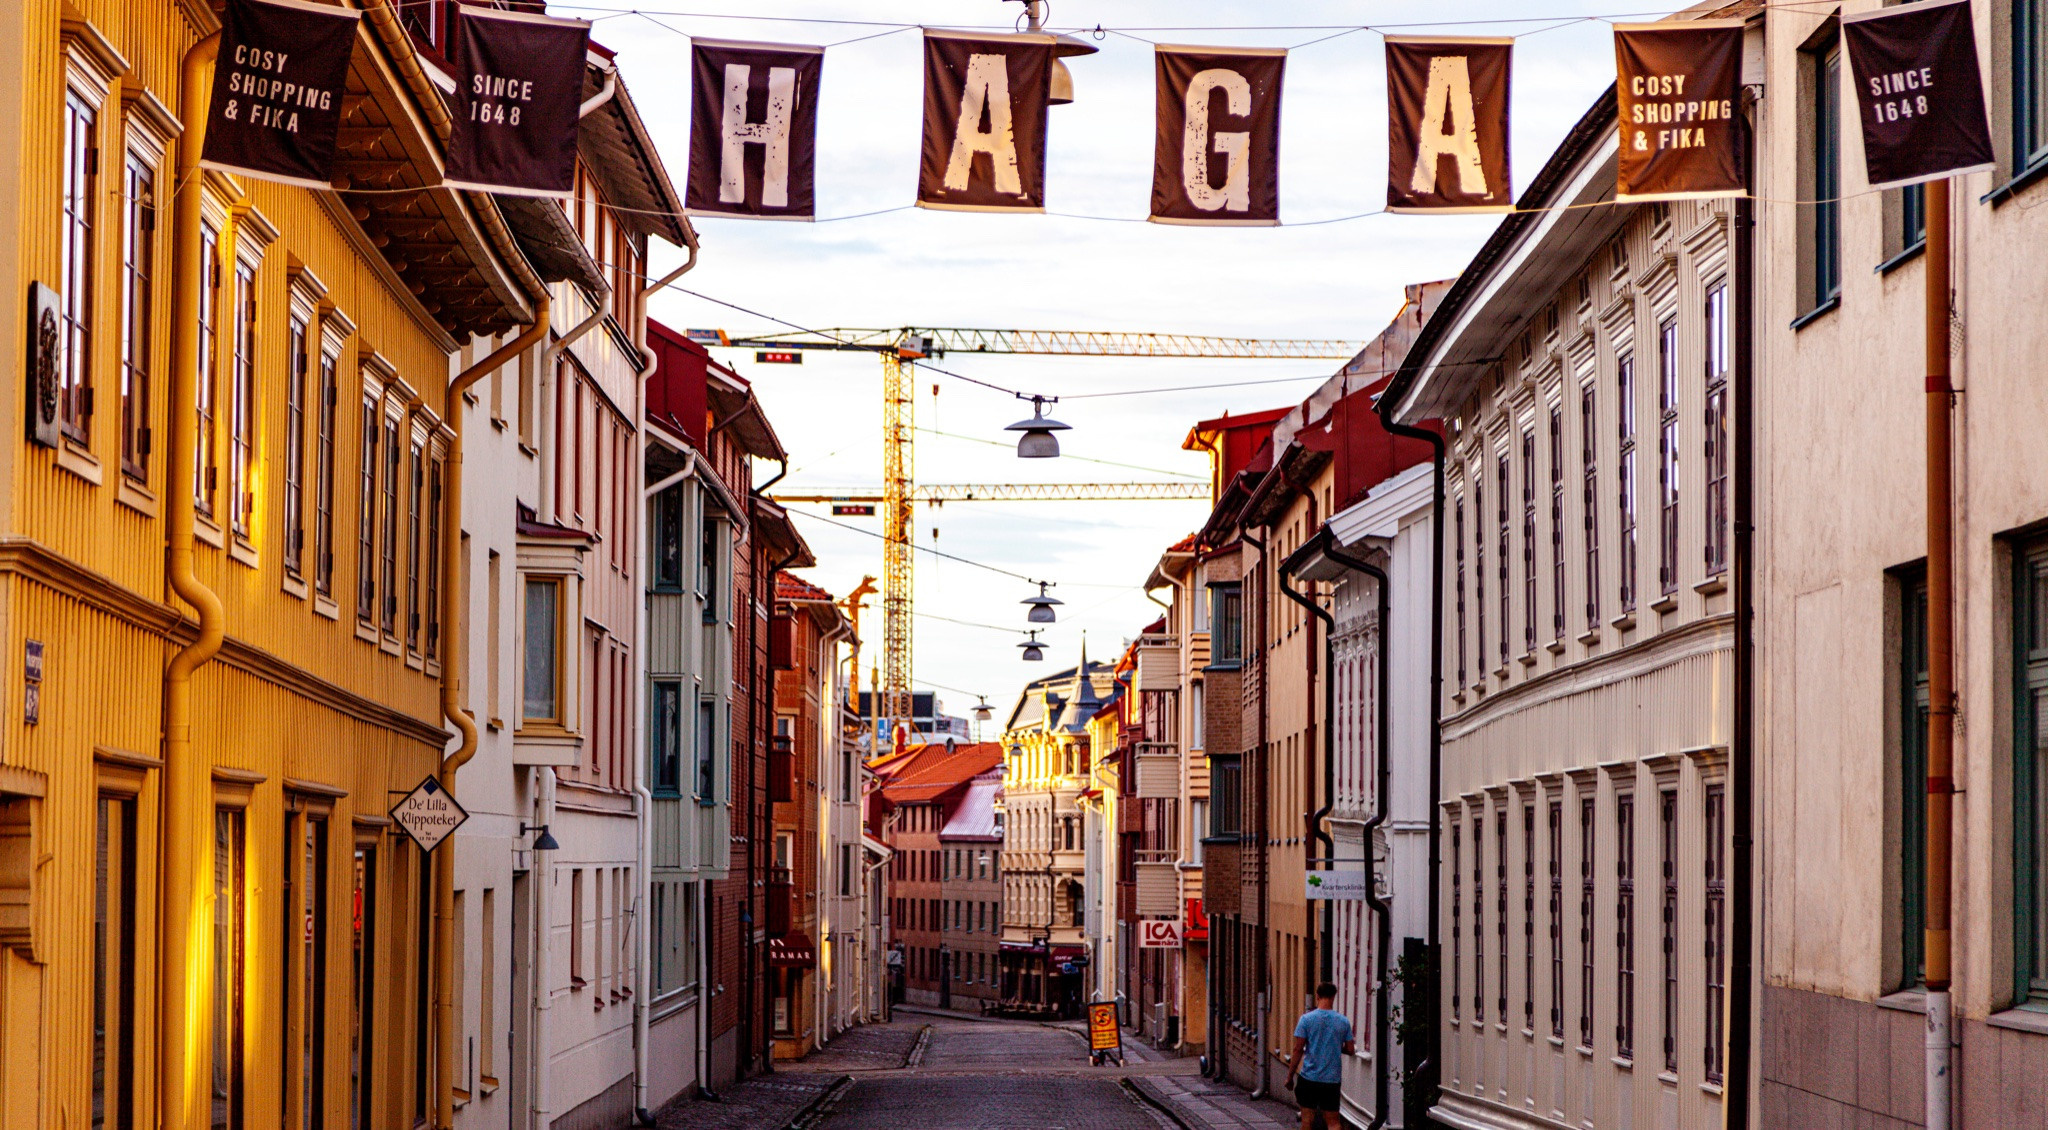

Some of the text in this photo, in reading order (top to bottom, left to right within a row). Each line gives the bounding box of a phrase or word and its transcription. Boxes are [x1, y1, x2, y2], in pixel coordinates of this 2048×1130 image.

[235, 45, 288, 74] COSY
[229, 73, 332, 111] SHOPPING
[473, 74, 533, 101] SINCE
[1632, 75, 1686, 96] COSY
[1871, 67, 1933, 96] SINCE
[224, 99, 298, 134] & FIKA
[470, 101, 521, 127] 1648
[1632, 100, 1732, 124] SHOPPING
[1874, 96, 1928, 124] 1648
[1632, 127, 1706, 151] & FIKA
[427, 799, 447, 811] Lilla
[402, 812, 456, 830] Klippoteket
[1146, 923, 1178, 939] ICA
[771, 951, 810, 959] RAMAR
